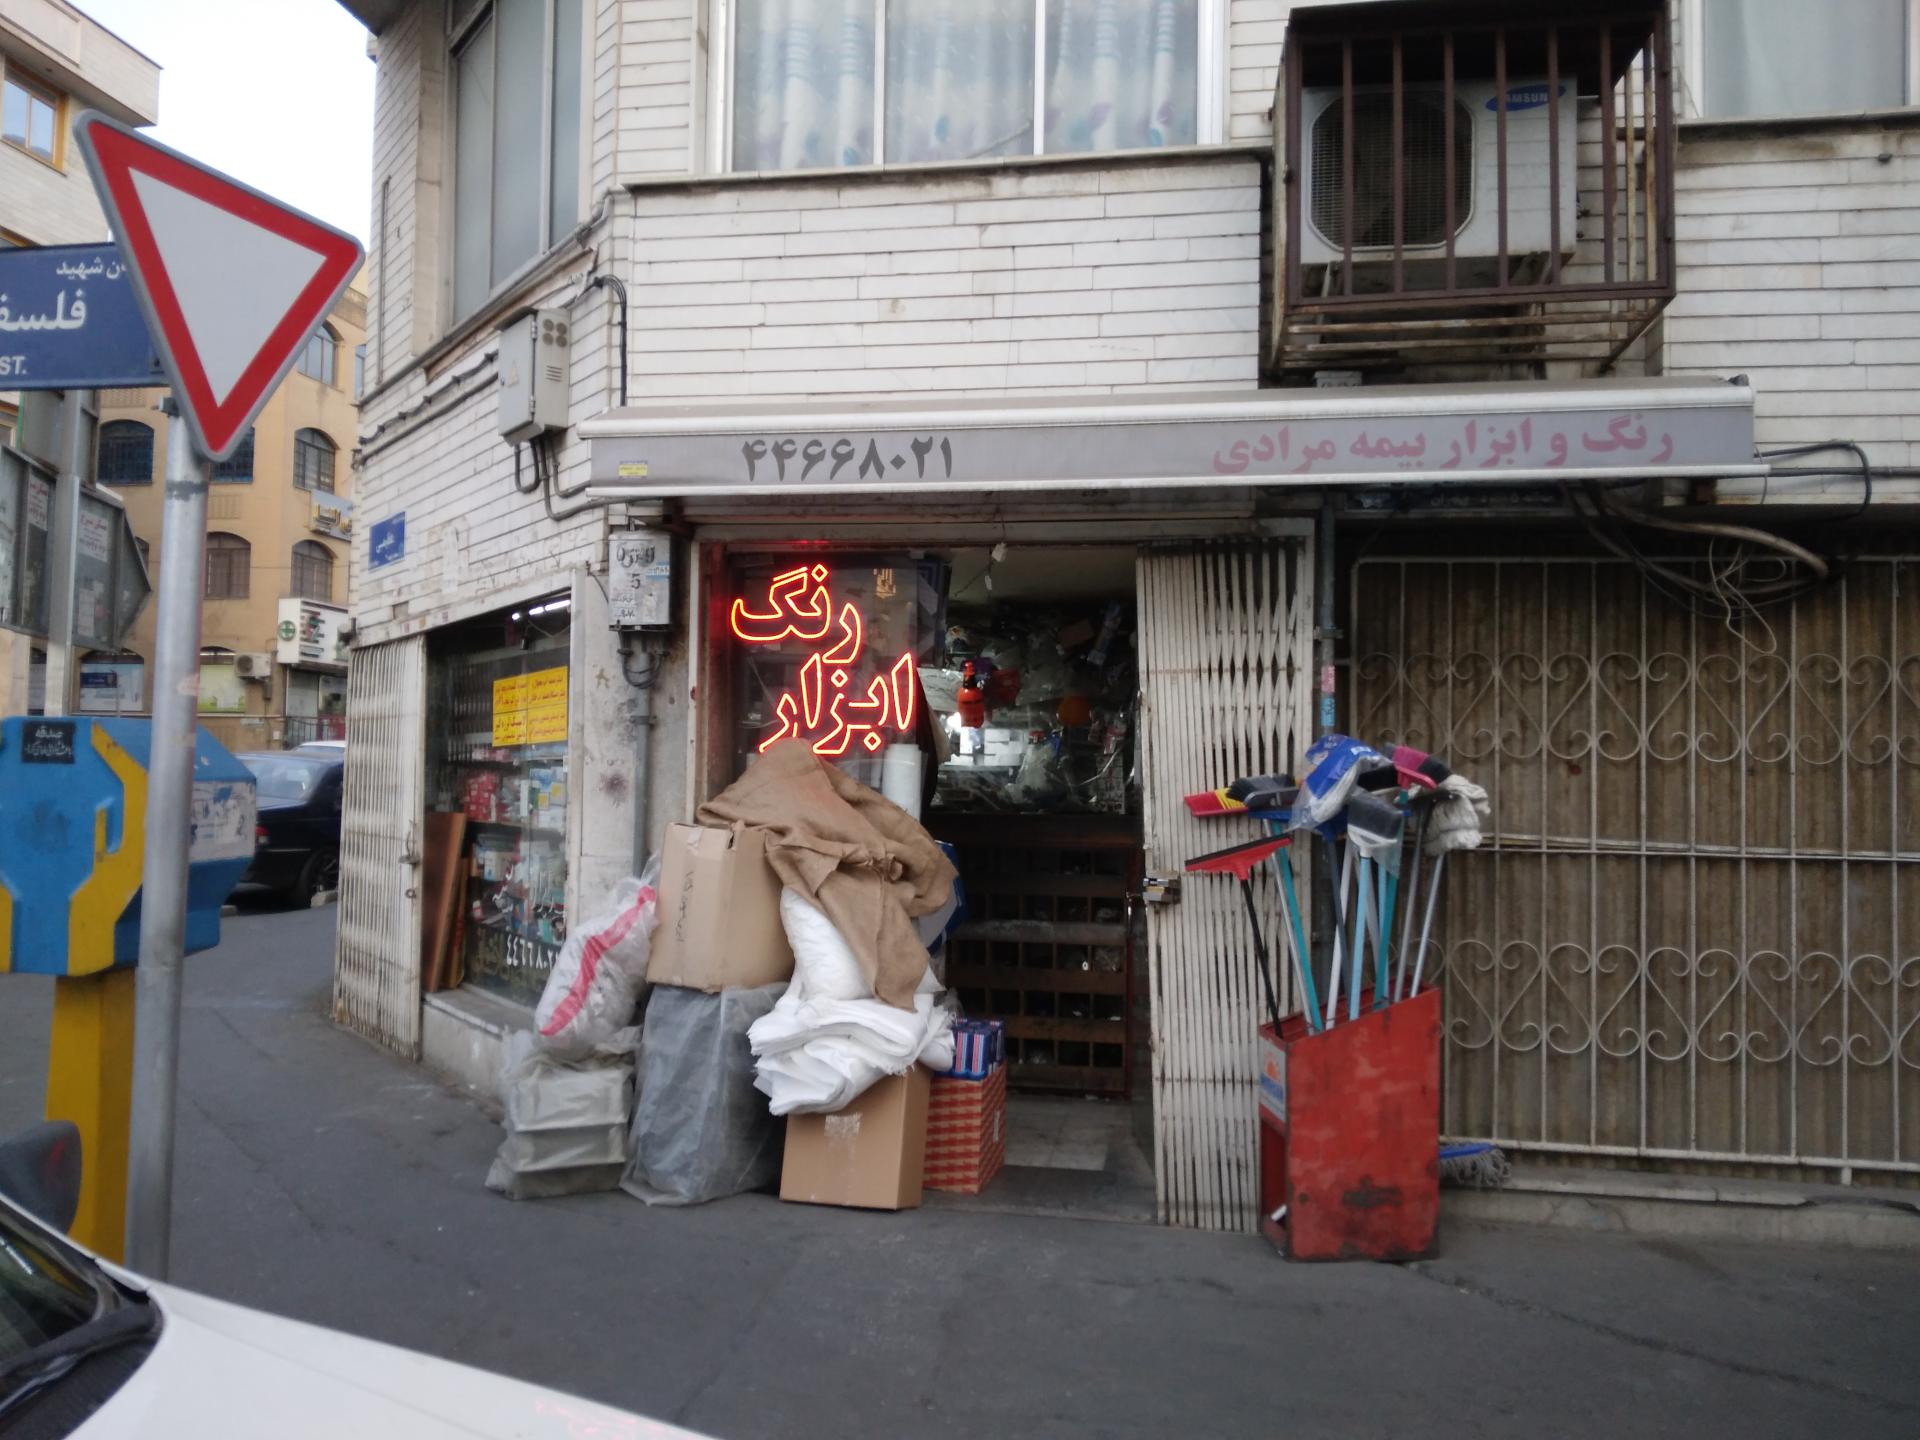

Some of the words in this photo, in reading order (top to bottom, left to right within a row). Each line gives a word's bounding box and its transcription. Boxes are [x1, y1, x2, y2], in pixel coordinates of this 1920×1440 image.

[56, 257, 104, 280] شهید
[0, 355, 27, 376] ST.
[742, 436, 953, 481] ۴۴۶۶۸۰۲۱
[1214, 426, 1337, 475] مرادی
[1350, 430, 1425, 468] بیمه
[1441, 417, 1532, 468] ابزار
[1547, 433, 1568, 465] و
[1582, 416, 1674, 464] رنگ
[731, 563, 861, 664] رنگ
[758, 652, 914, 754] ابزار
